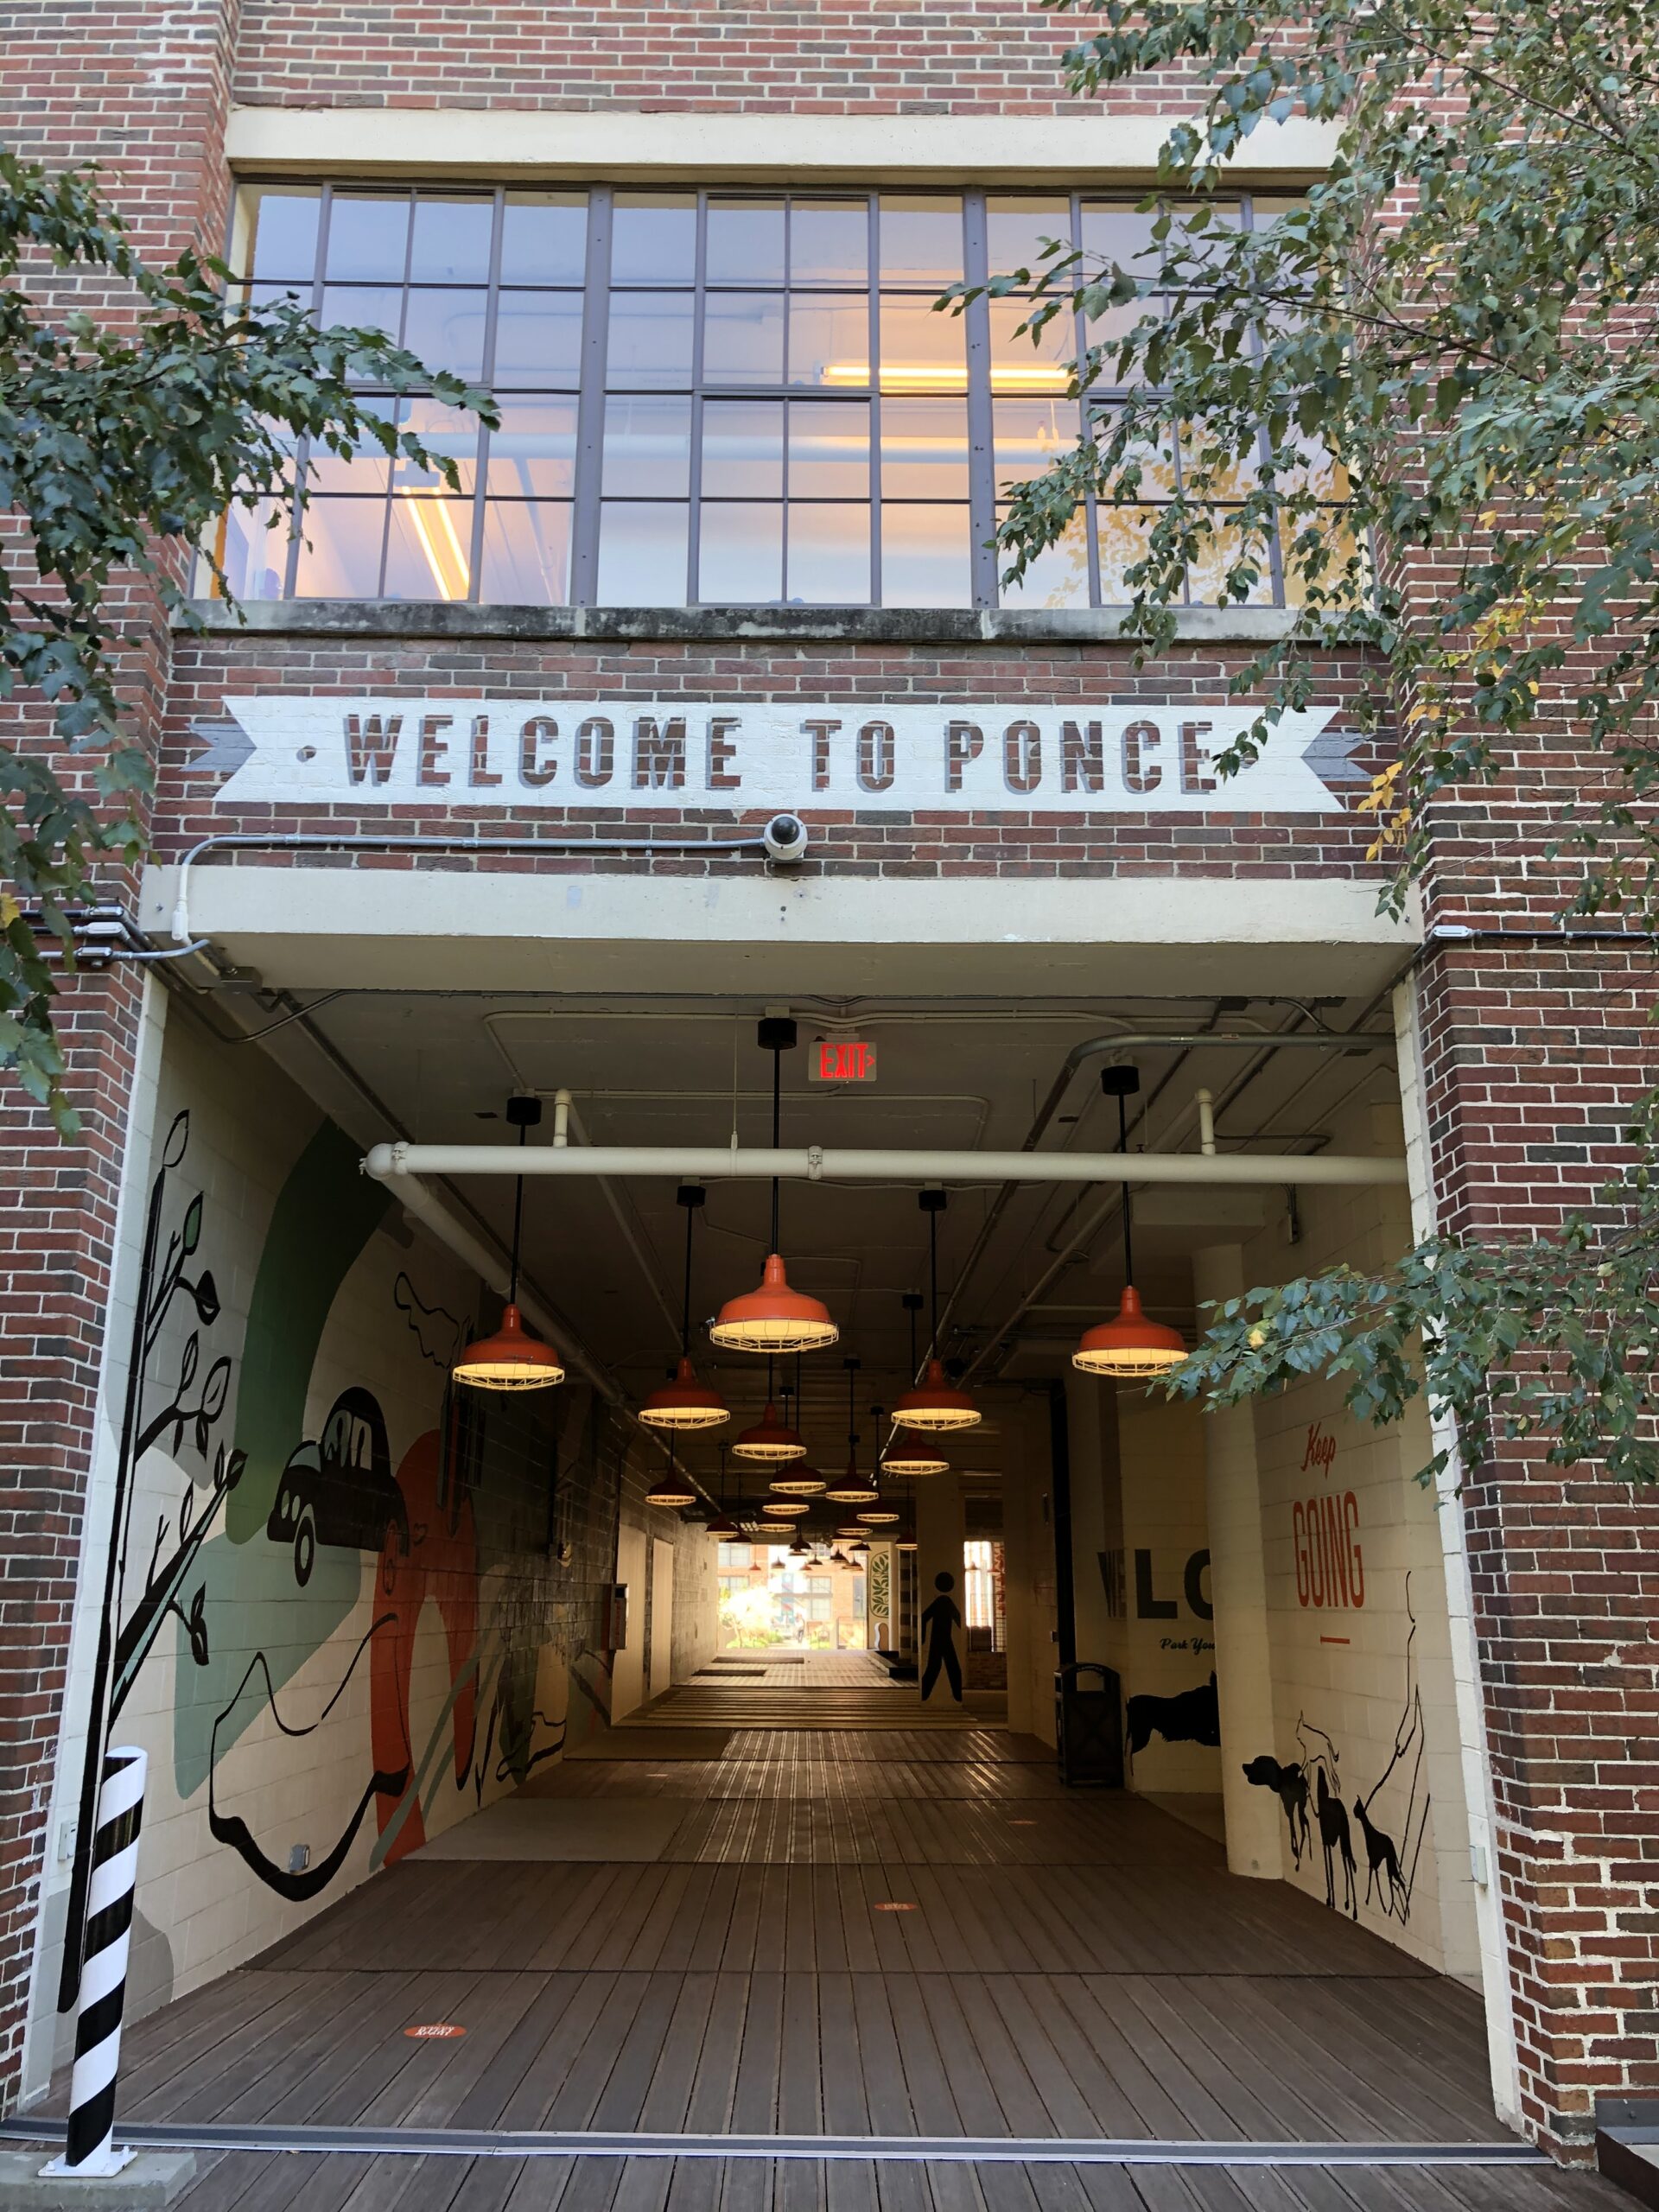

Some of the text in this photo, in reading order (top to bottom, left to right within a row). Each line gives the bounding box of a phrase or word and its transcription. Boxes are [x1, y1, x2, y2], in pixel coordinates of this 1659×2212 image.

[344, 714, 1217, 794] WELCOME TO PONCE
[820, 1043, 868, 1078] EXIT
[1300, 1421, 1336, 1479] Keep
[1293, 1491, 1364, 1609] GOING
[1160, 1637, 1188, 1650] Park
